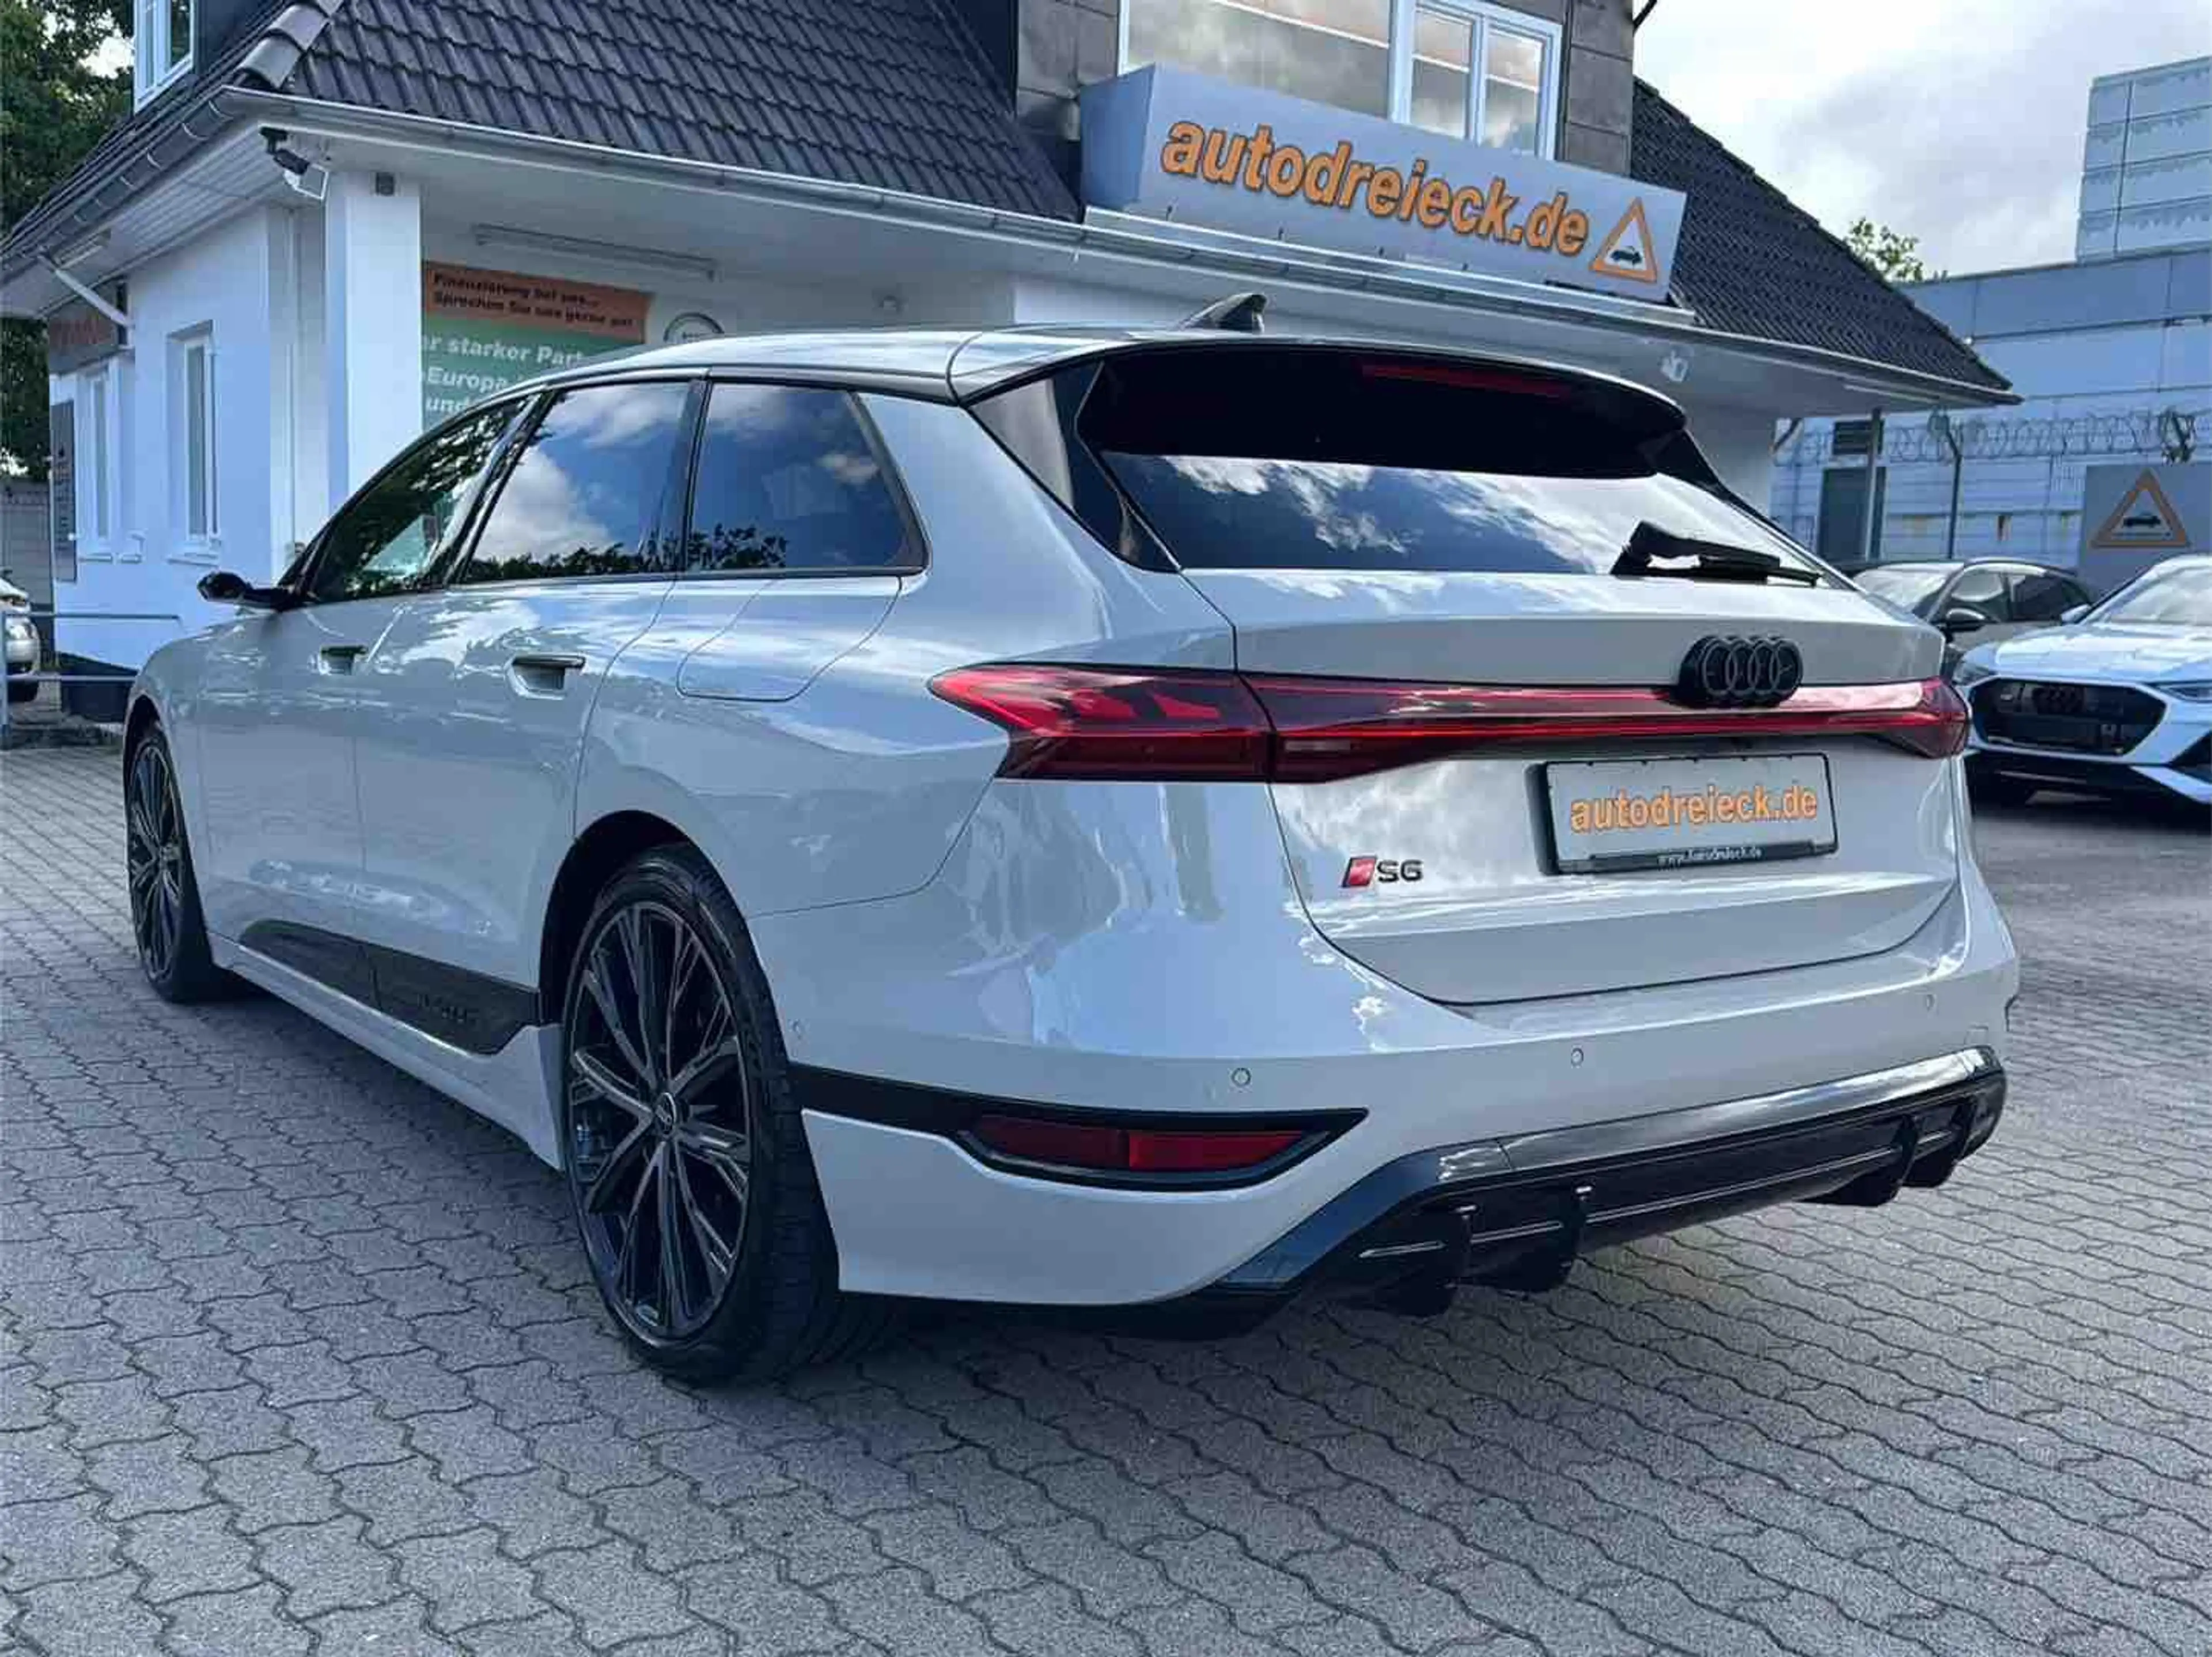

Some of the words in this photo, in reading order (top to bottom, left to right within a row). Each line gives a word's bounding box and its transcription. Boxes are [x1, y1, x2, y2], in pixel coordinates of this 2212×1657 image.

[1161, 120, 1590, 258] autodreieck.de
[434, 290, 505, 310] Sprechen
[565, 308, 606, 324] gerne
[1570, 782, 1818, 834] autodreieck.de
[1376, 858, 1423, 883] S6
